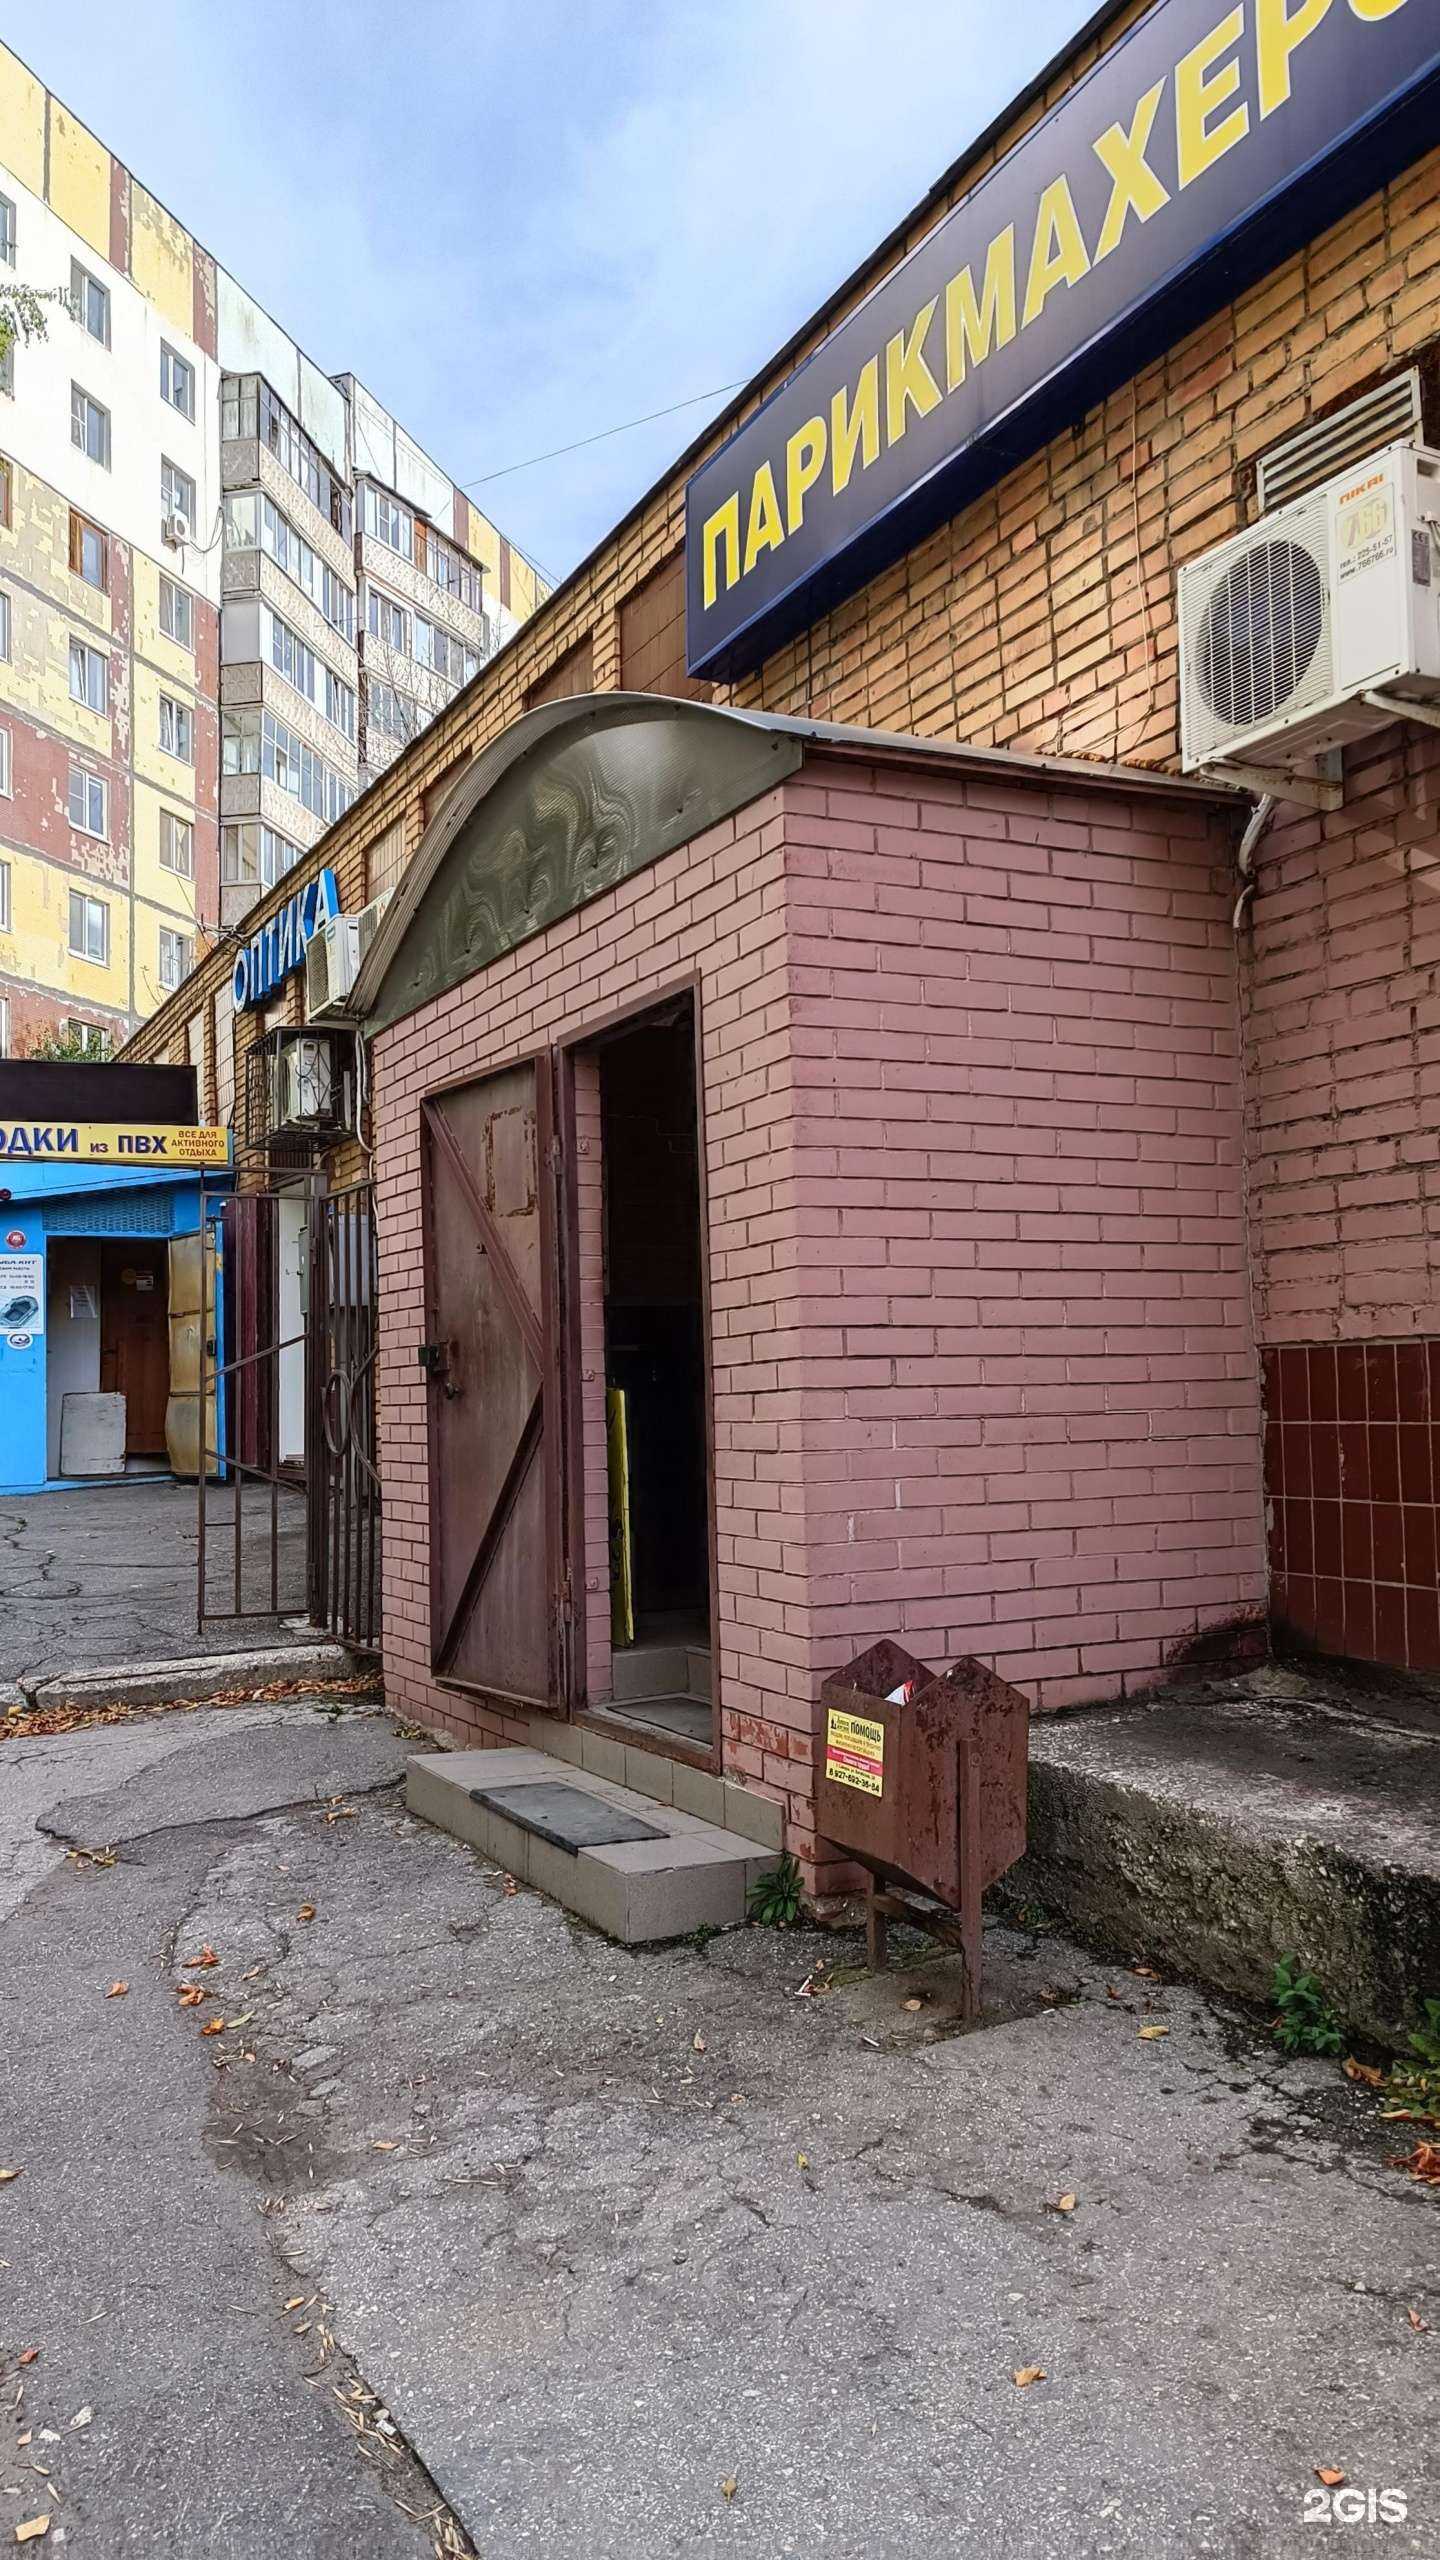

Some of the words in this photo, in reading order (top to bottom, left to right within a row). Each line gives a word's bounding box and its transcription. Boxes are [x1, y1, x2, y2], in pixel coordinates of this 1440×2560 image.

[702, 0, 1410, 611] ПАРИКМАХЕР
[233, 867, 340, 1014] ОПТИКА
[118, 1135, 168, 1154] ПВХ
[171, 1139, 225, 1148] АКТИВНОГО
[178, 1130, 196, 1139] ВСЕ
[198, 1131, 217, 1140] ДЛЯ
[179, 1147, 217, 1157] ОТДЫХА
[850, 1721, 882, 1743] ПОМОЩЬ
